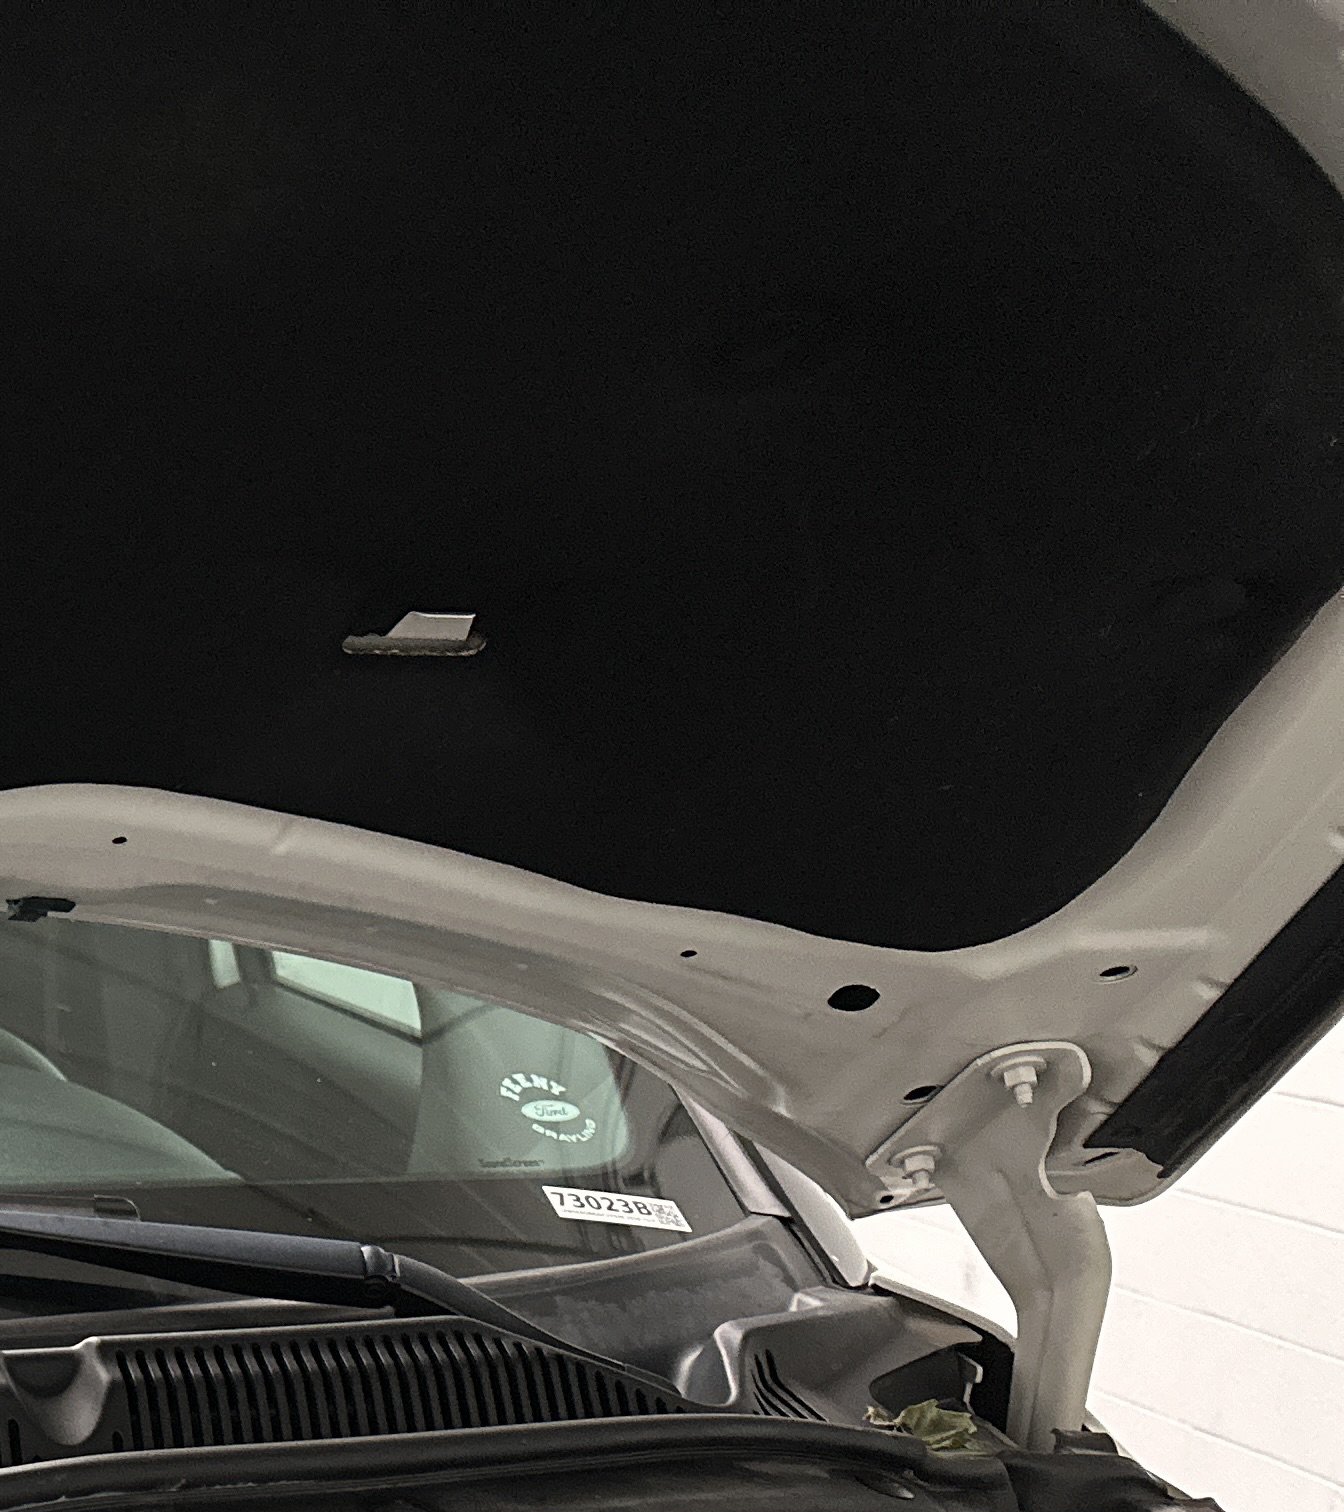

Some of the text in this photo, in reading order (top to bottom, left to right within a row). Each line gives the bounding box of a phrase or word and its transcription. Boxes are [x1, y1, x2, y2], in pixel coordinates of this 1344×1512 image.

[500, 1073, 566, 1101] FEENY
[533, 1104, 569, 1117] Ford
[532, 1118, 596, 1143] GRAYLING
[550, 1191, 653, 1216] 73023B
